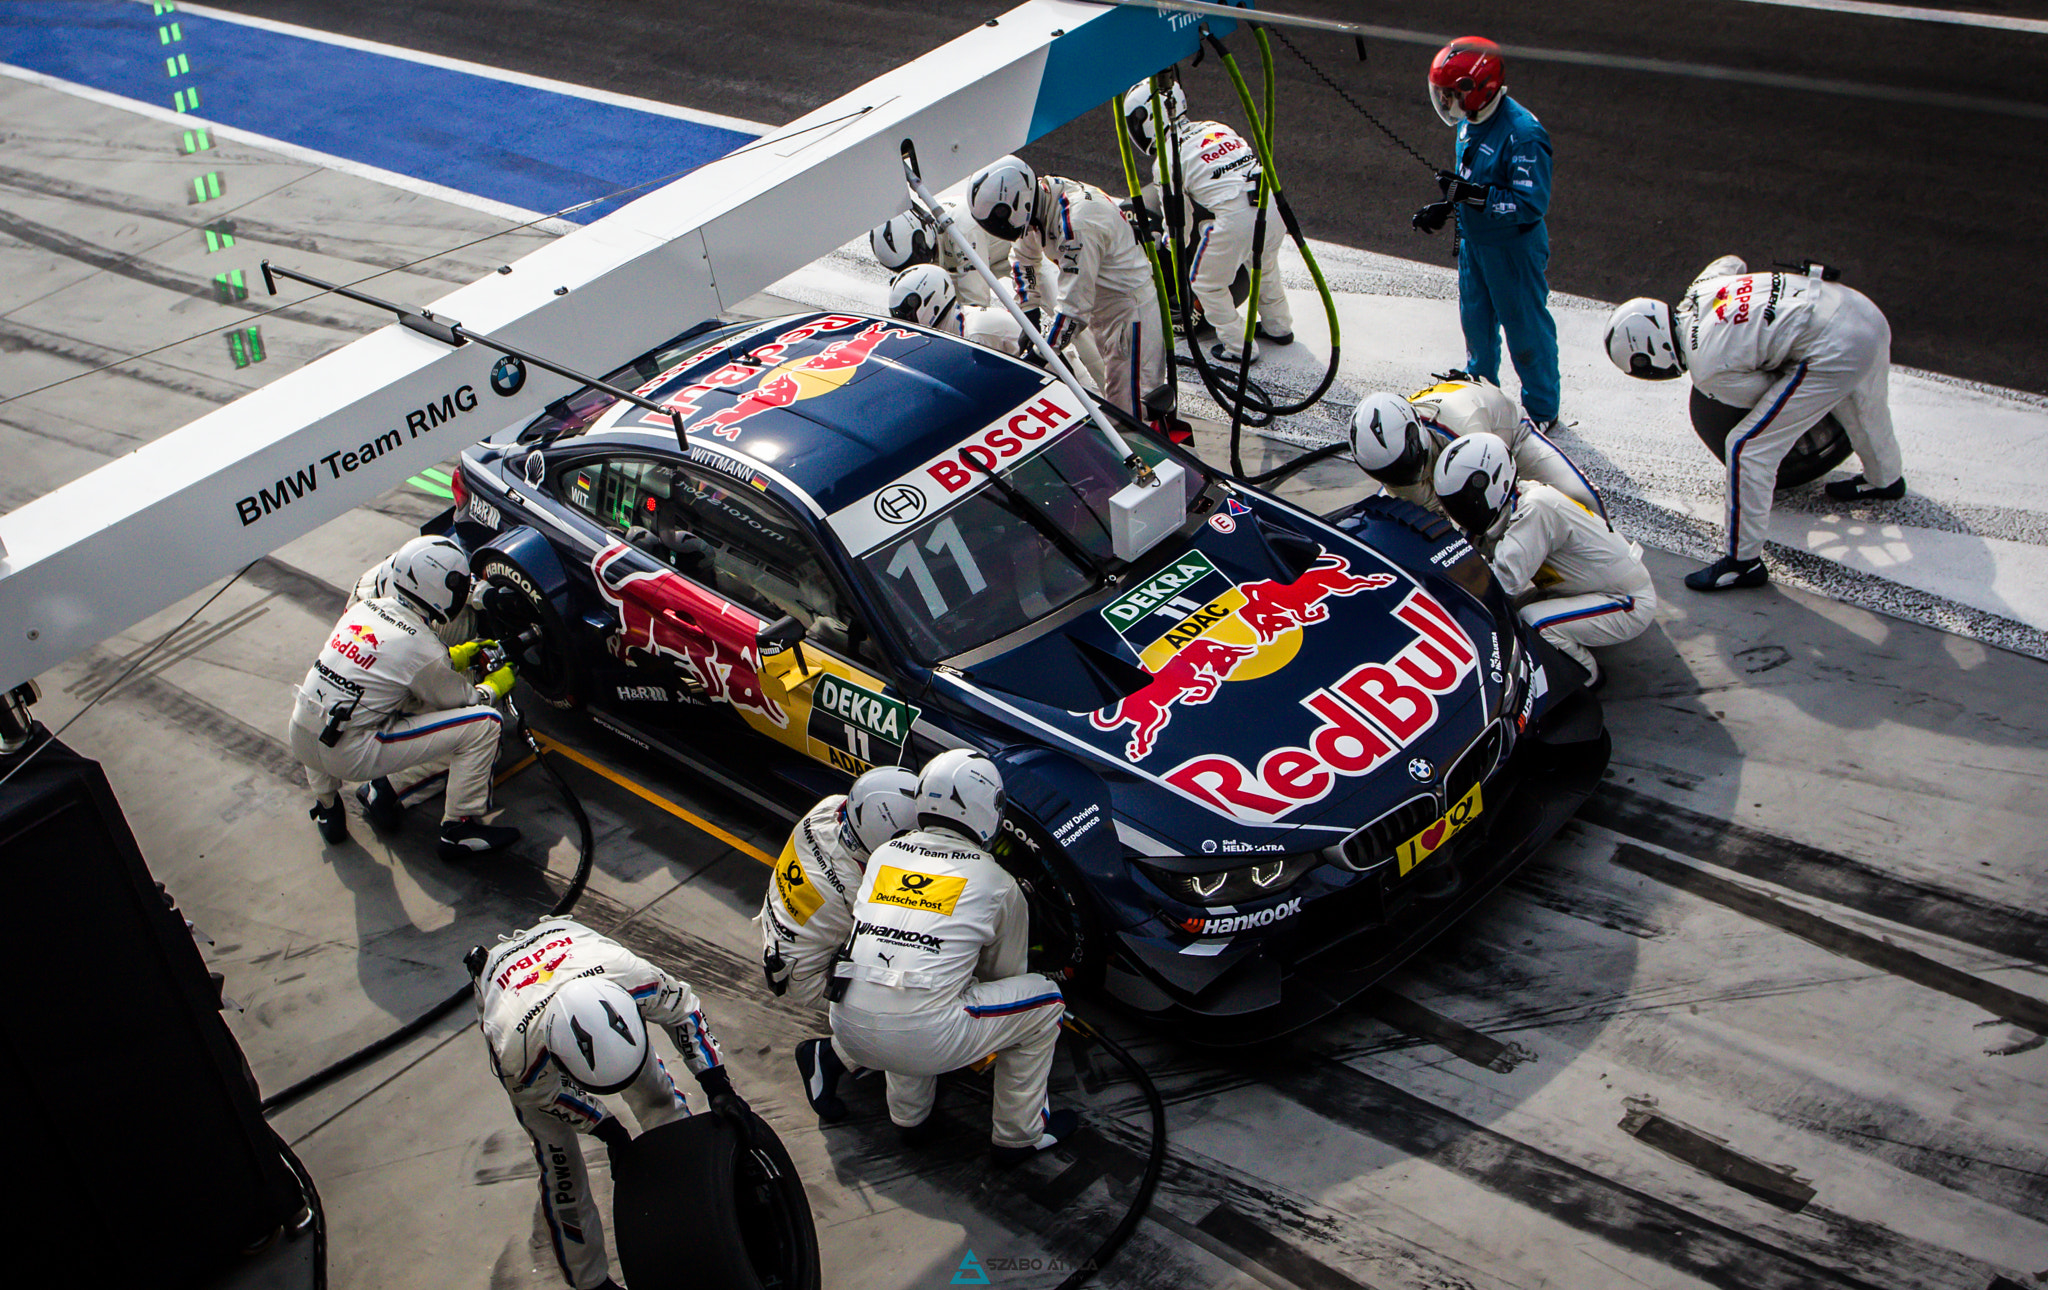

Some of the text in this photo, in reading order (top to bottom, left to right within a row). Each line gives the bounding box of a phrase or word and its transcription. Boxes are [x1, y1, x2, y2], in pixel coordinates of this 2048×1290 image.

[235, 384, 479, 527] BMW Team RMG
[927, 396, 1074, 495] BOSCH
[690, 446, 755, 482] WITTMANN
[571, 486, 590, 508] WIT
[1215, 516, 1231, 530] E
[1430, 538, 1468, 564] BMW Driving
[1442, 545, 1474, 568] Experience
[886, 516, 990, 622] 11
[1109, 564, 1208, 622] DEKRA
[1153, 595, 1202, 621] 11
[379, 609, 397, 625] Team
[395, 621, 418, 637] RMG
[1164, 604, 1230, 650] ADAC
[760, 647, 781, 655] PUMA
[822, 681, 899, 740] DEKRA
[844, 723, 870, 762] 11
[1052, 822, 1074, 841] BMW
[1071, 802, 1100, 827] Driving
[1060, 816, 1101, 848] Experience
[803, 817, 846, 894] BMW Team RMG
[889, 840, 981, 860] BMW Team RMG
[1408, 839, 1417, 868] I
[785, 898, 799, 918] Post
[876, 892, 942, 911] Deutsche Post
[516, 1005, 541, 1034] RMG
[548, 1144, 576, 1204] Power
